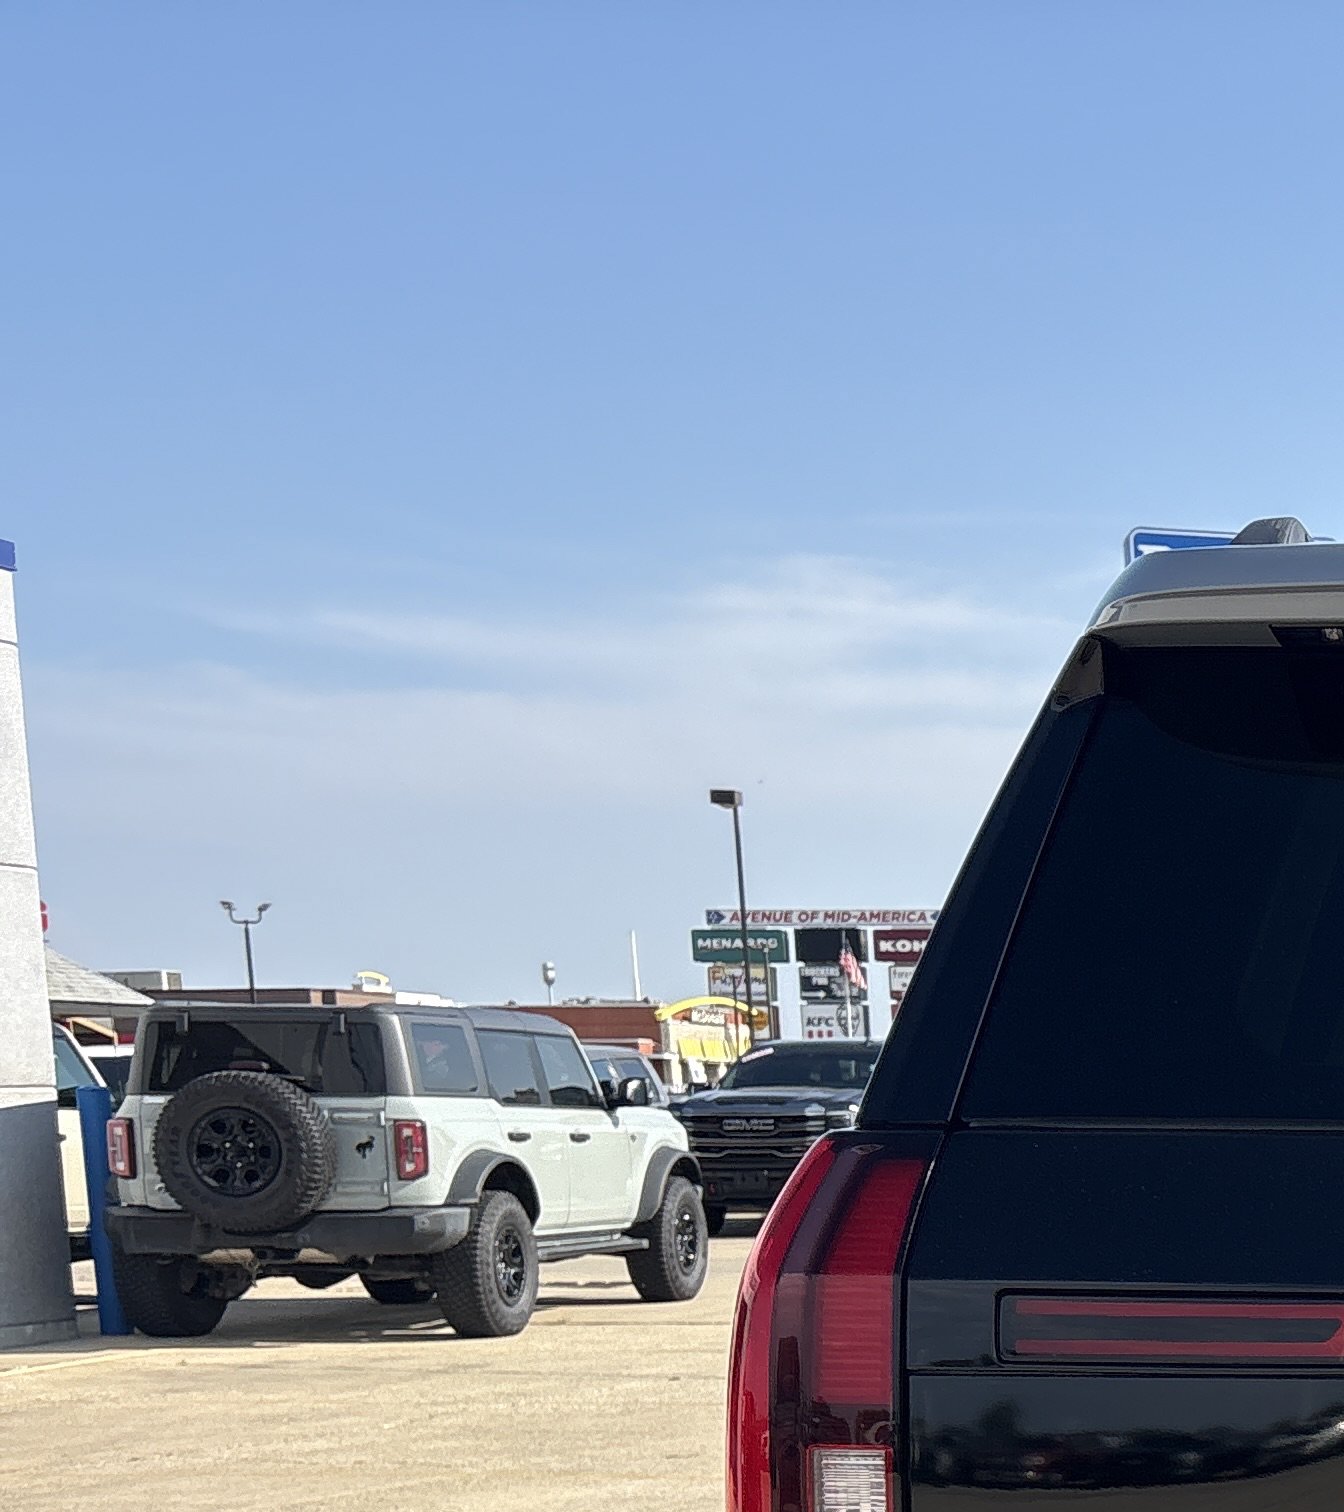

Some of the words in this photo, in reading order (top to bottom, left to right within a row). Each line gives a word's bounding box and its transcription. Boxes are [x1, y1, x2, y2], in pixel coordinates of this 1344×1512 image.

[797, 911, 818, 922] OF
[823, 911, 928, 922] MID-AMERICA
[879, 939, 927, 952] KOH
[806, 1016, 835, 1027] KFC
